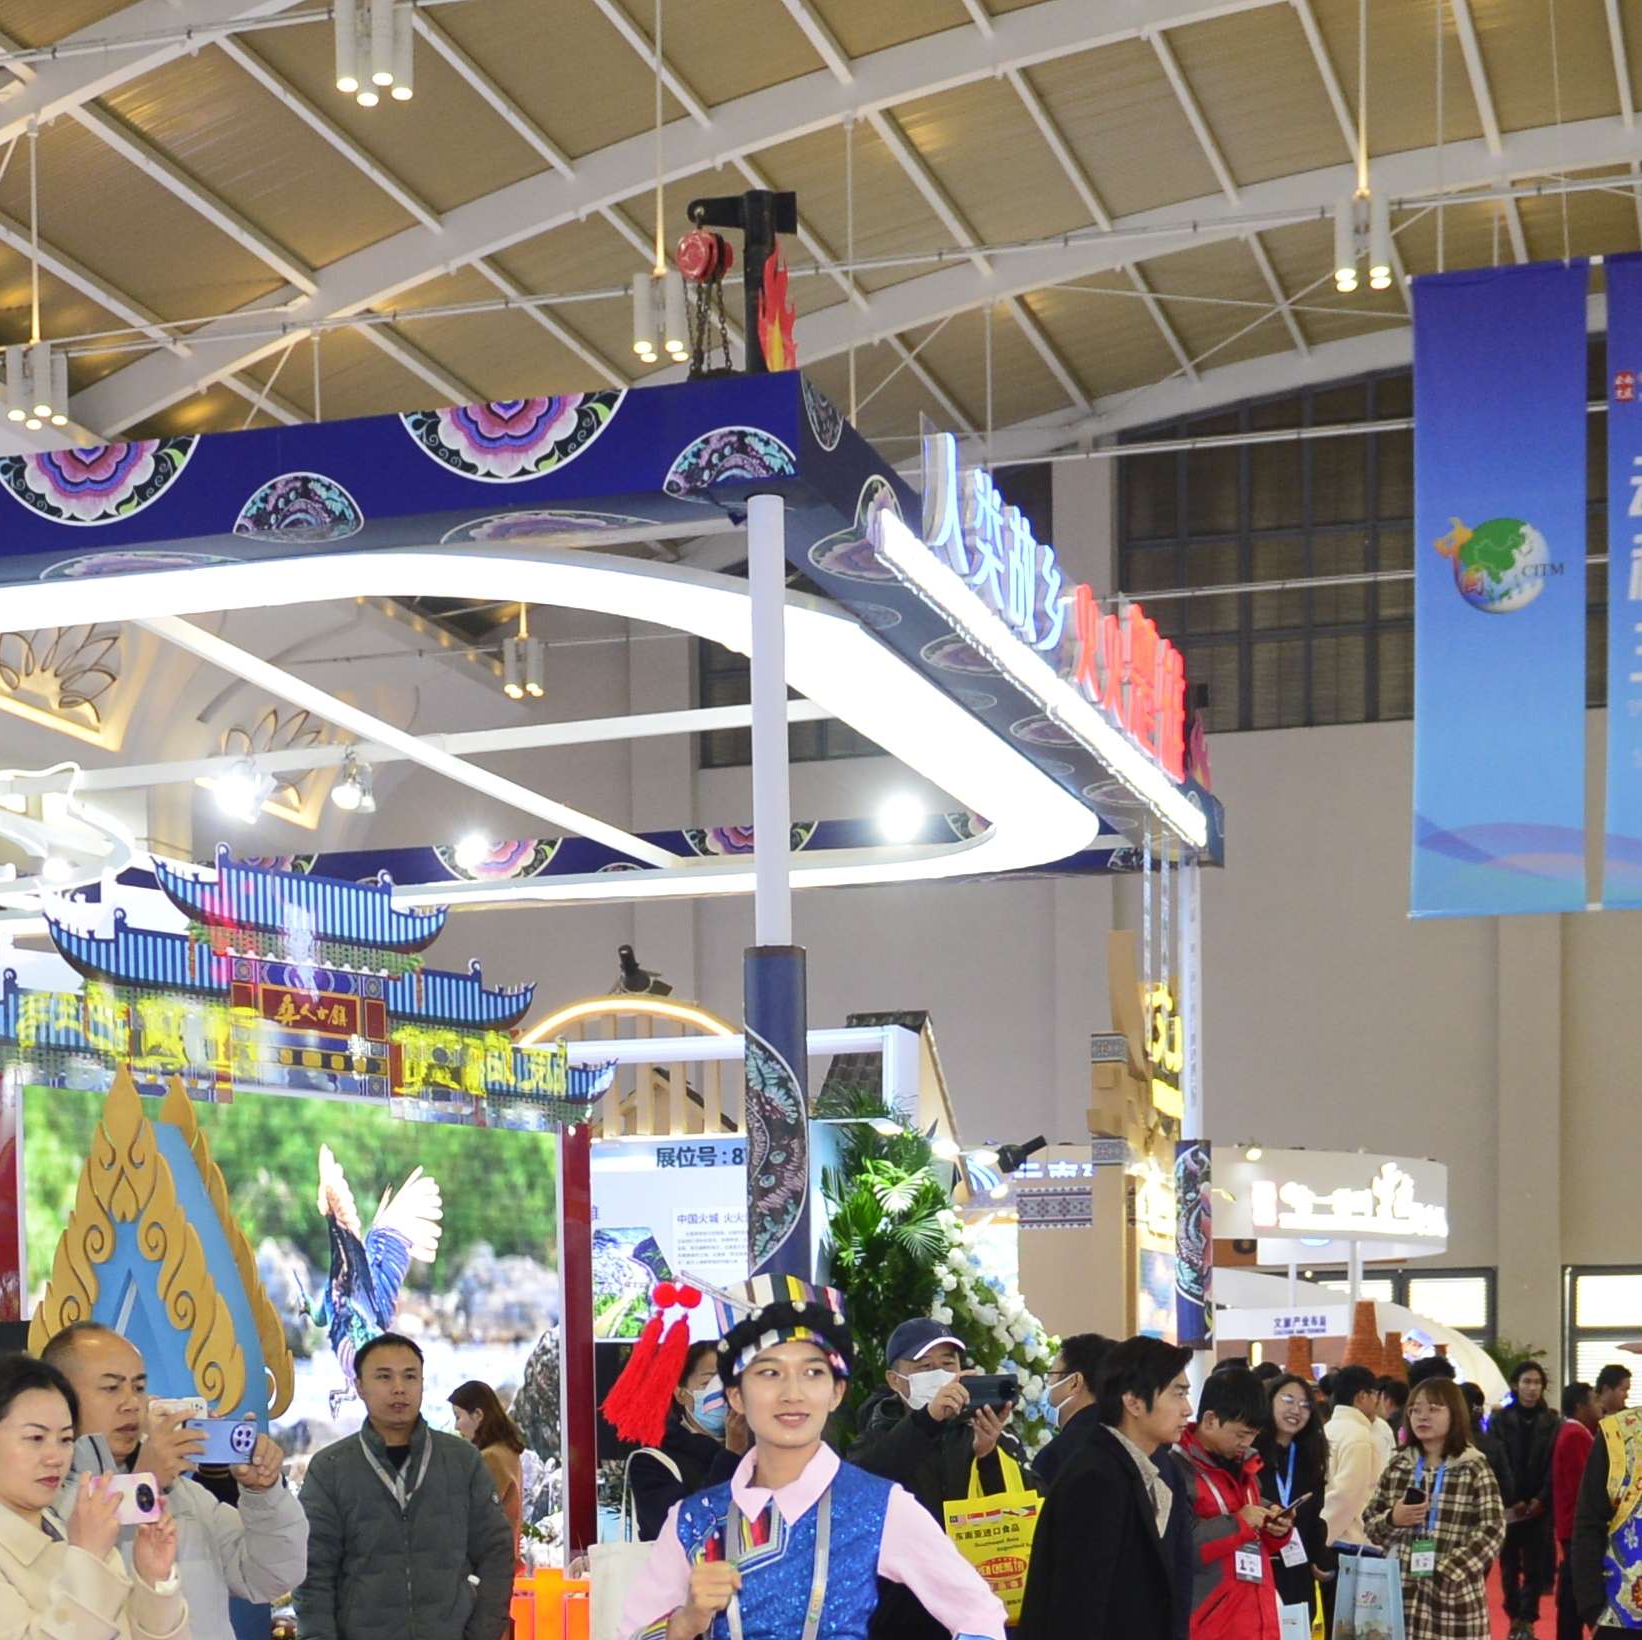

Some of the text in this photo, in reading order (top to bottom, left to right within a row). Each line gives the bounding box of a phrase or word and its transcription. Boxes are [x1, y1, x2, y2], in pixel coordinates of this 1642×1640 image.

[927, 432, 1065, 652] 人类故乡
[1521, 563, 1565, 577] CITM
[656, 1145, 748, 1168] 展位号：8
[677, 1212, 720, 1225] 中国火城
[955, 1523, 1020, 1540] 东南亚进口食品
